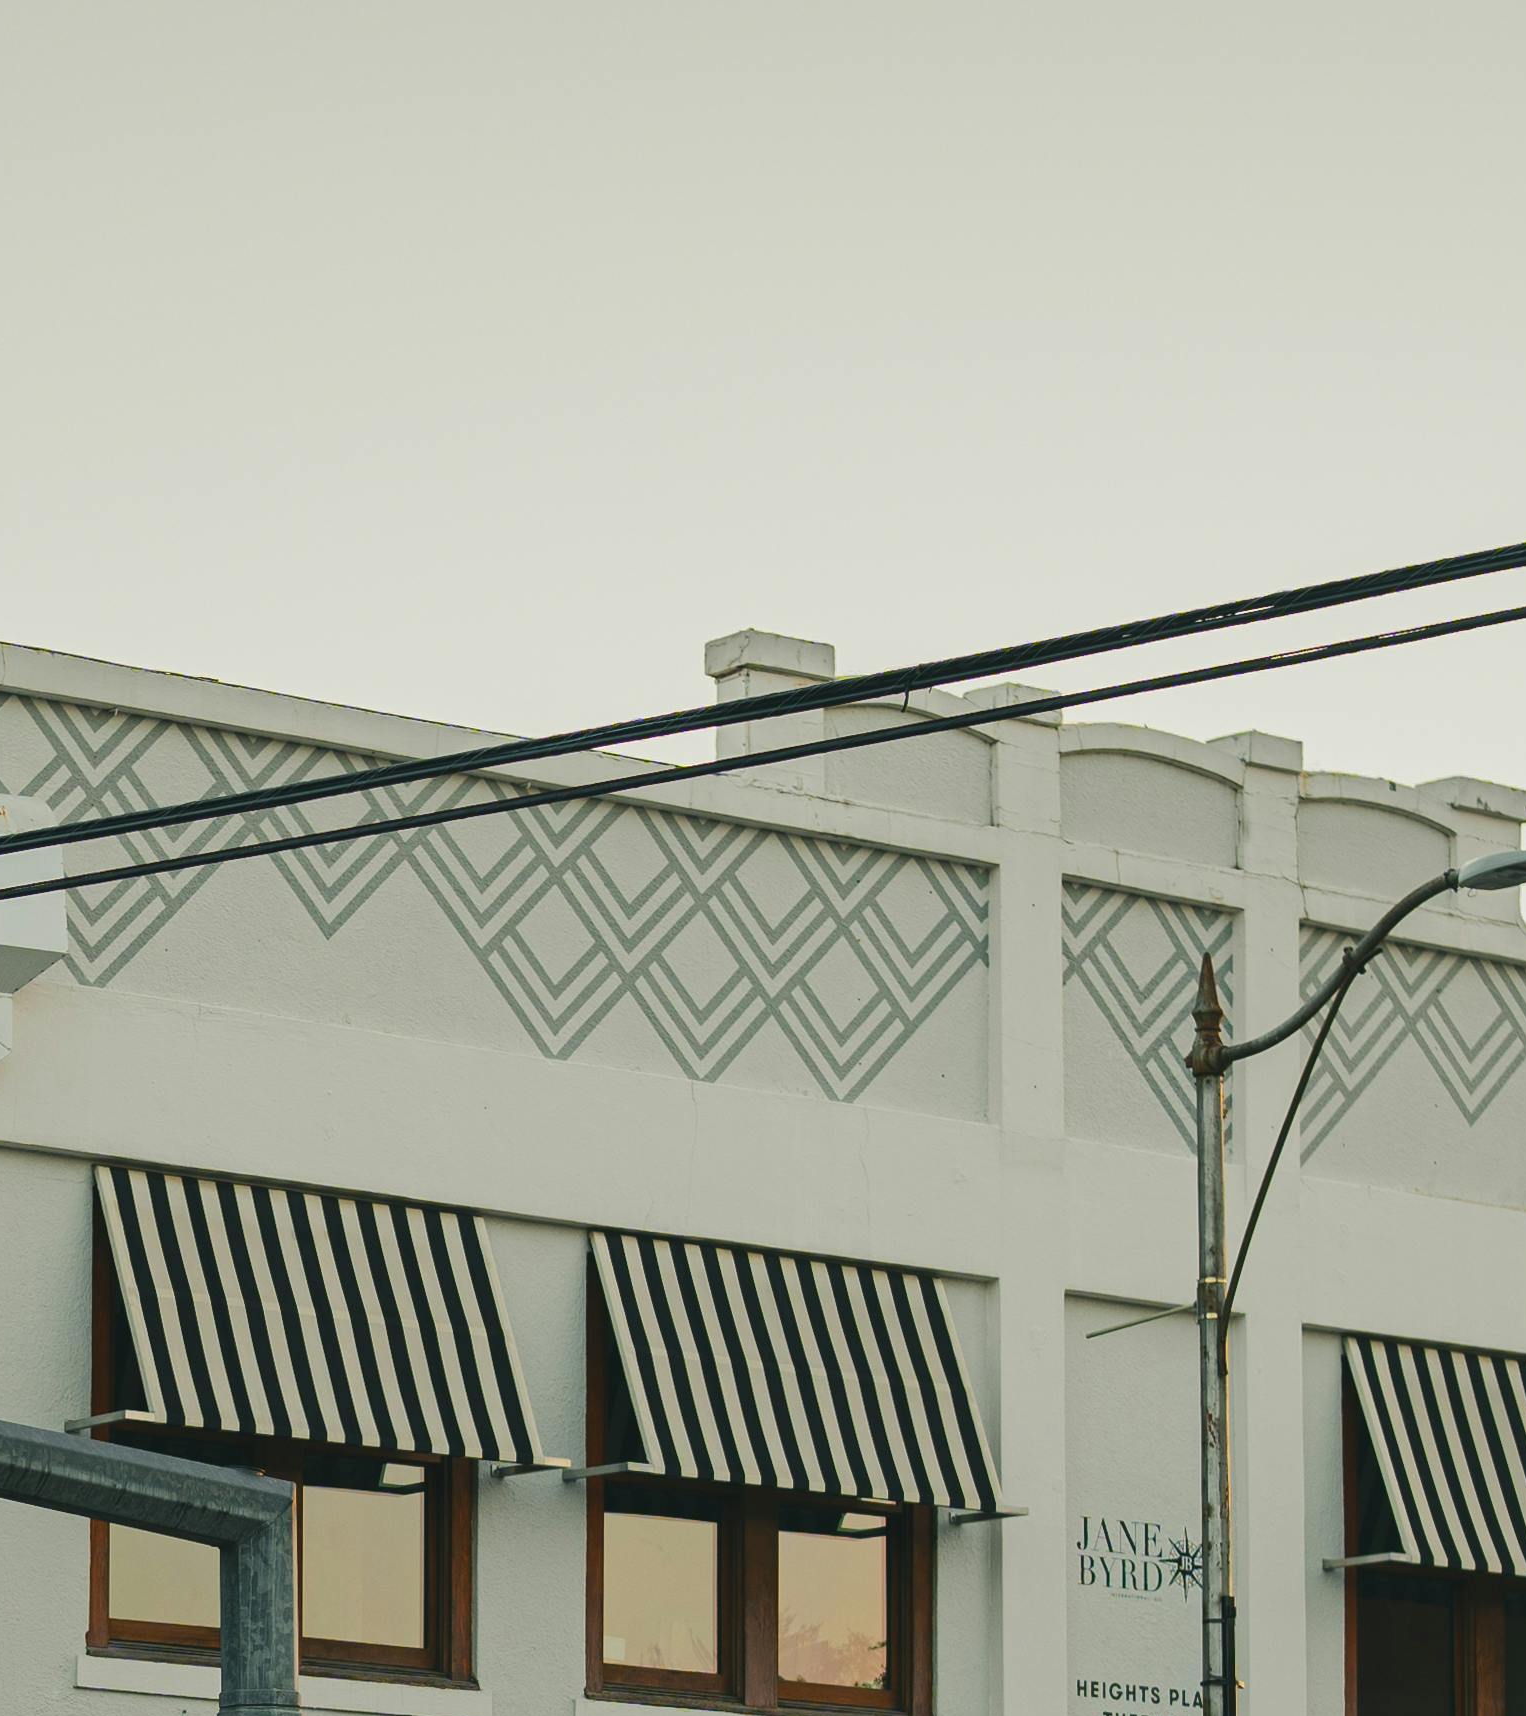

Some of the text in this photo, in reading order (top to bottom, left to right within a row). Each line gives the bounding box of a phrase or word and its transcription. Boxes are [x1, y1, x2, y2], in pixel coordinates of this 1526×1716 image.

[1076, 1515, 1164, 1558] JANE
[1076, 1554, 1164, 1593] BYRD
[1076, 1679, 1203, 1709] HEIGHTS PLA
